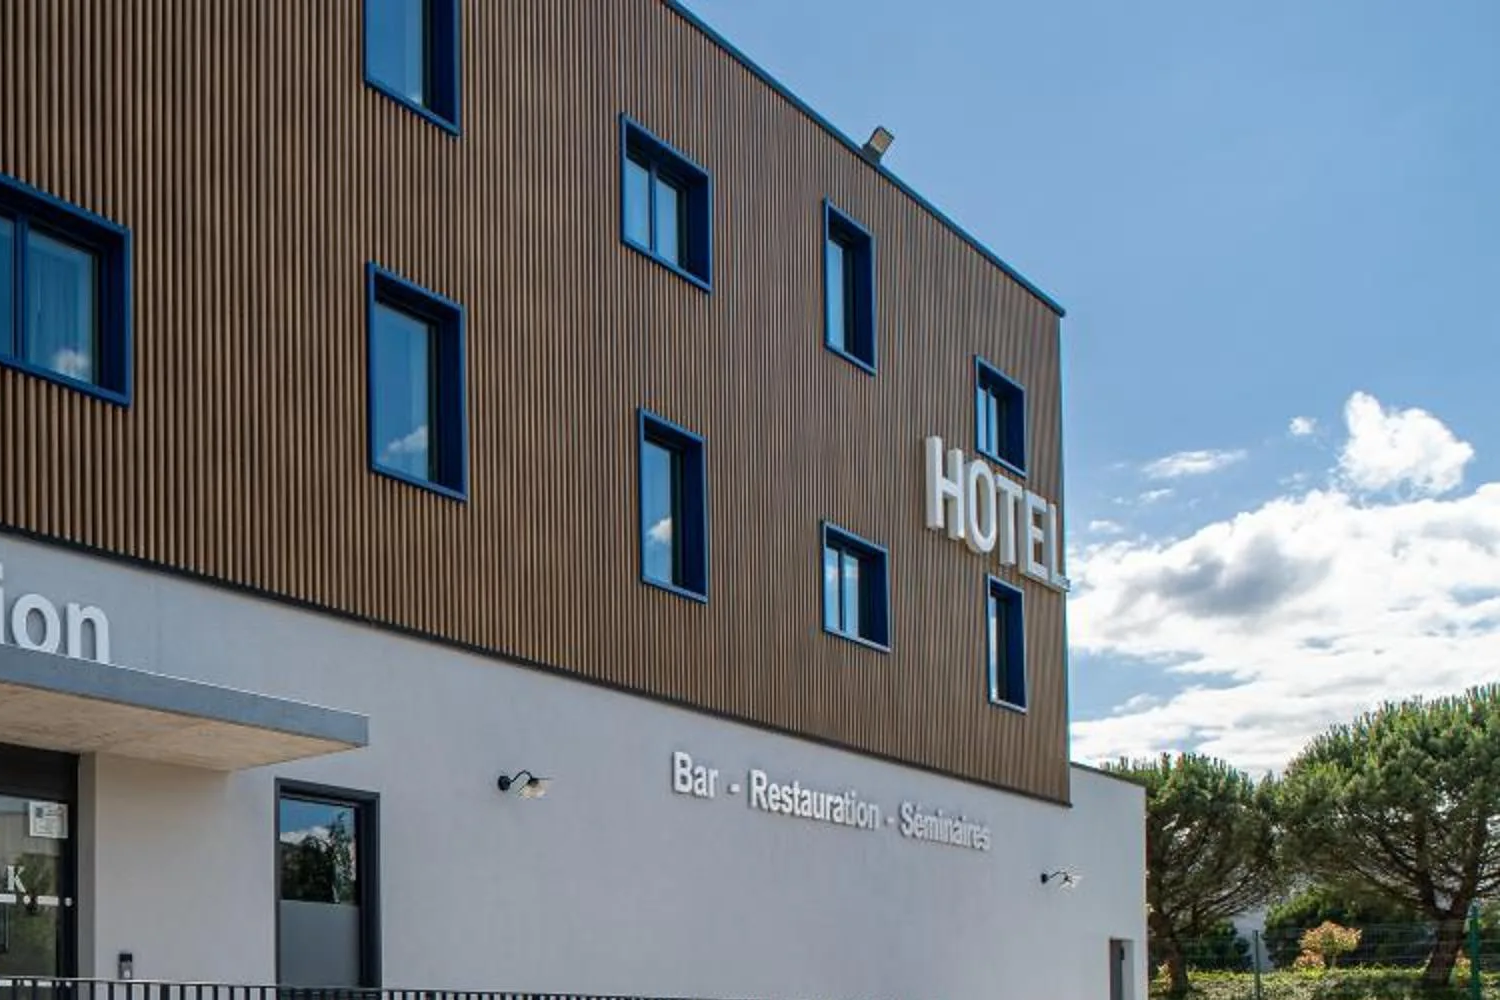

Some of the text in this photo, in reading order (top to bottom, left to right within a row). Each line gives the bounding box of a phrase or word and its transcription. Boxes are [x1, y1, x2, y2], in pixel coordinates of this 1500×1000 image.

[926, 436, 1070, 591] HOTEL
[672, 751, 718, 797] Bar
[750, 769, 881, 829] Restauration
[900, 801, 991, 850] Séminaires
